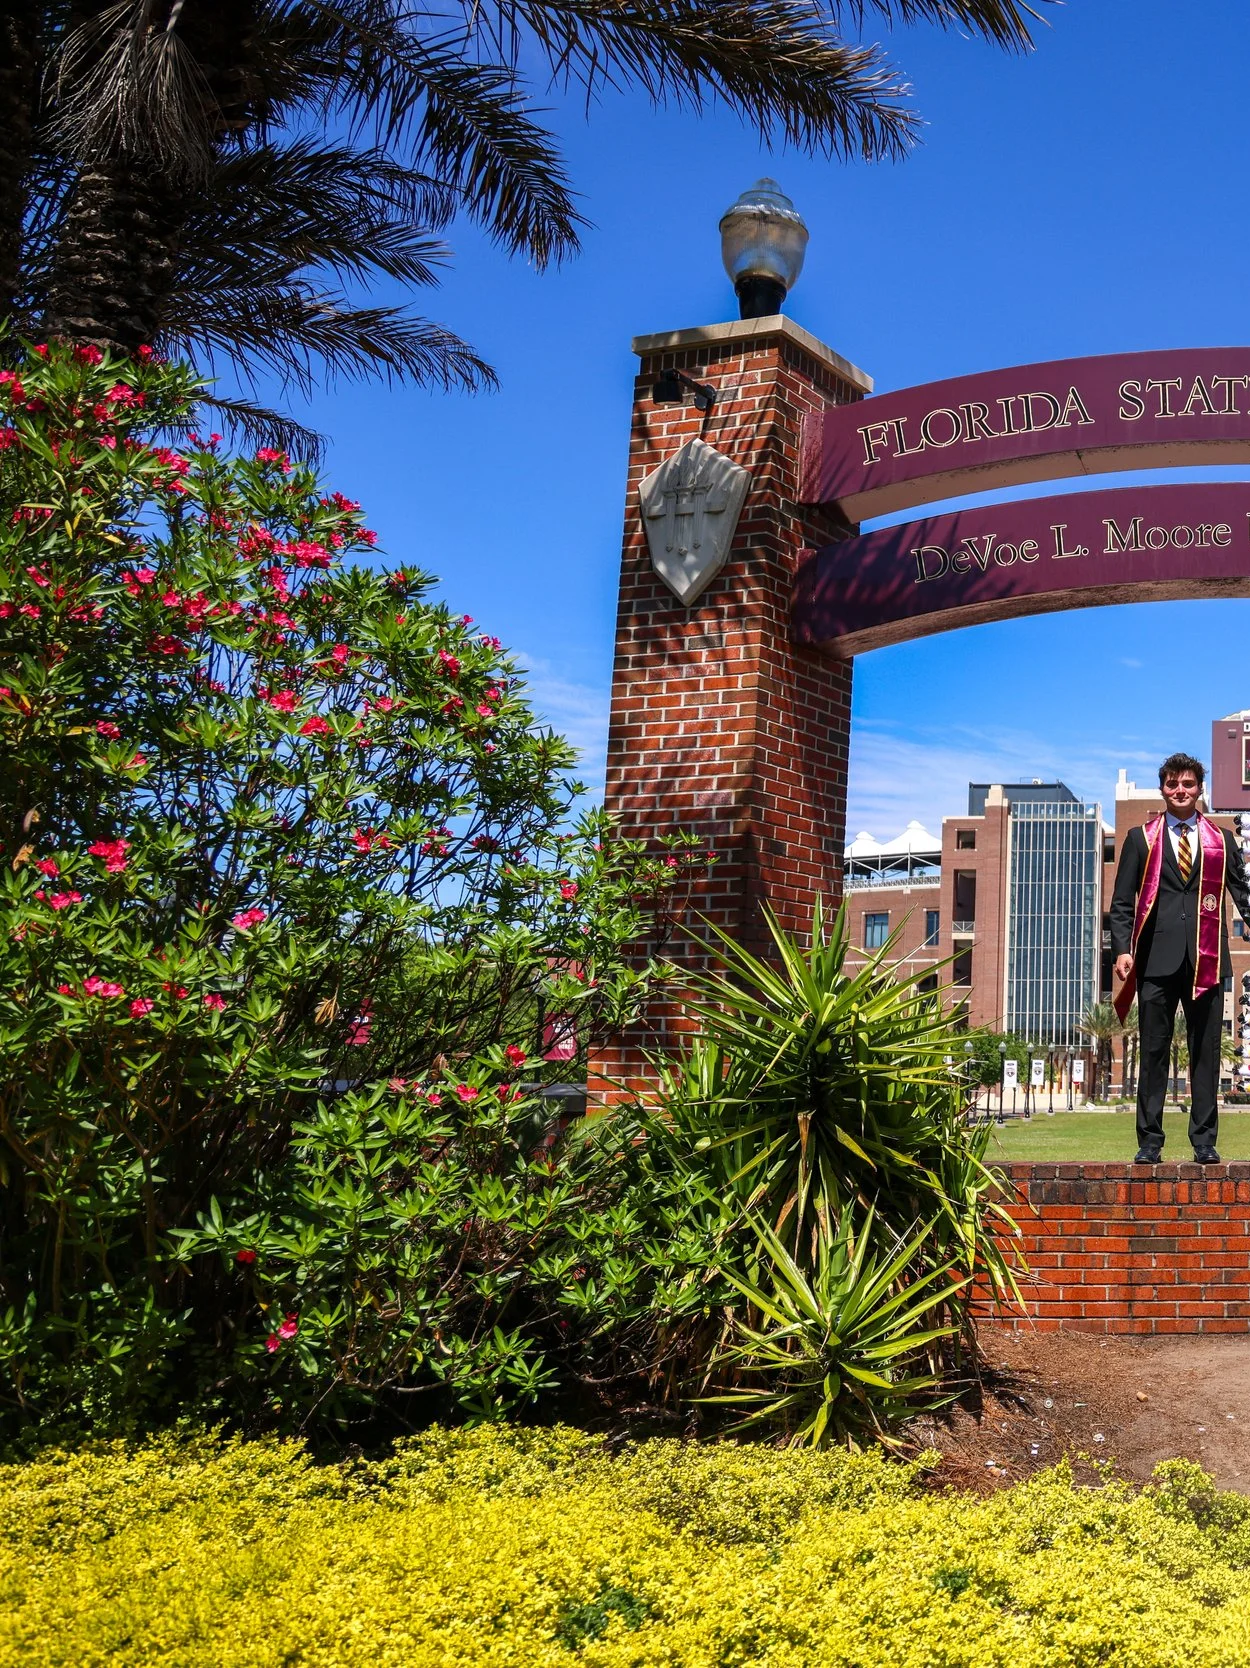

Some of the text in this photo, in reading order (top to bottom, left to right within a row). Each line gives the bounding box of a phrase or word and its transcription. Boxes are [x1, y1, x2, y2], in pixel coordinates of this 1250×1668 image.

[857, 386, 1095, 465] FLORIDA
[910, 534, 1040, 583] DeVoe
[1050, 524, 1090, 559] L.
[1102, 516, 1232, 553] Moore
